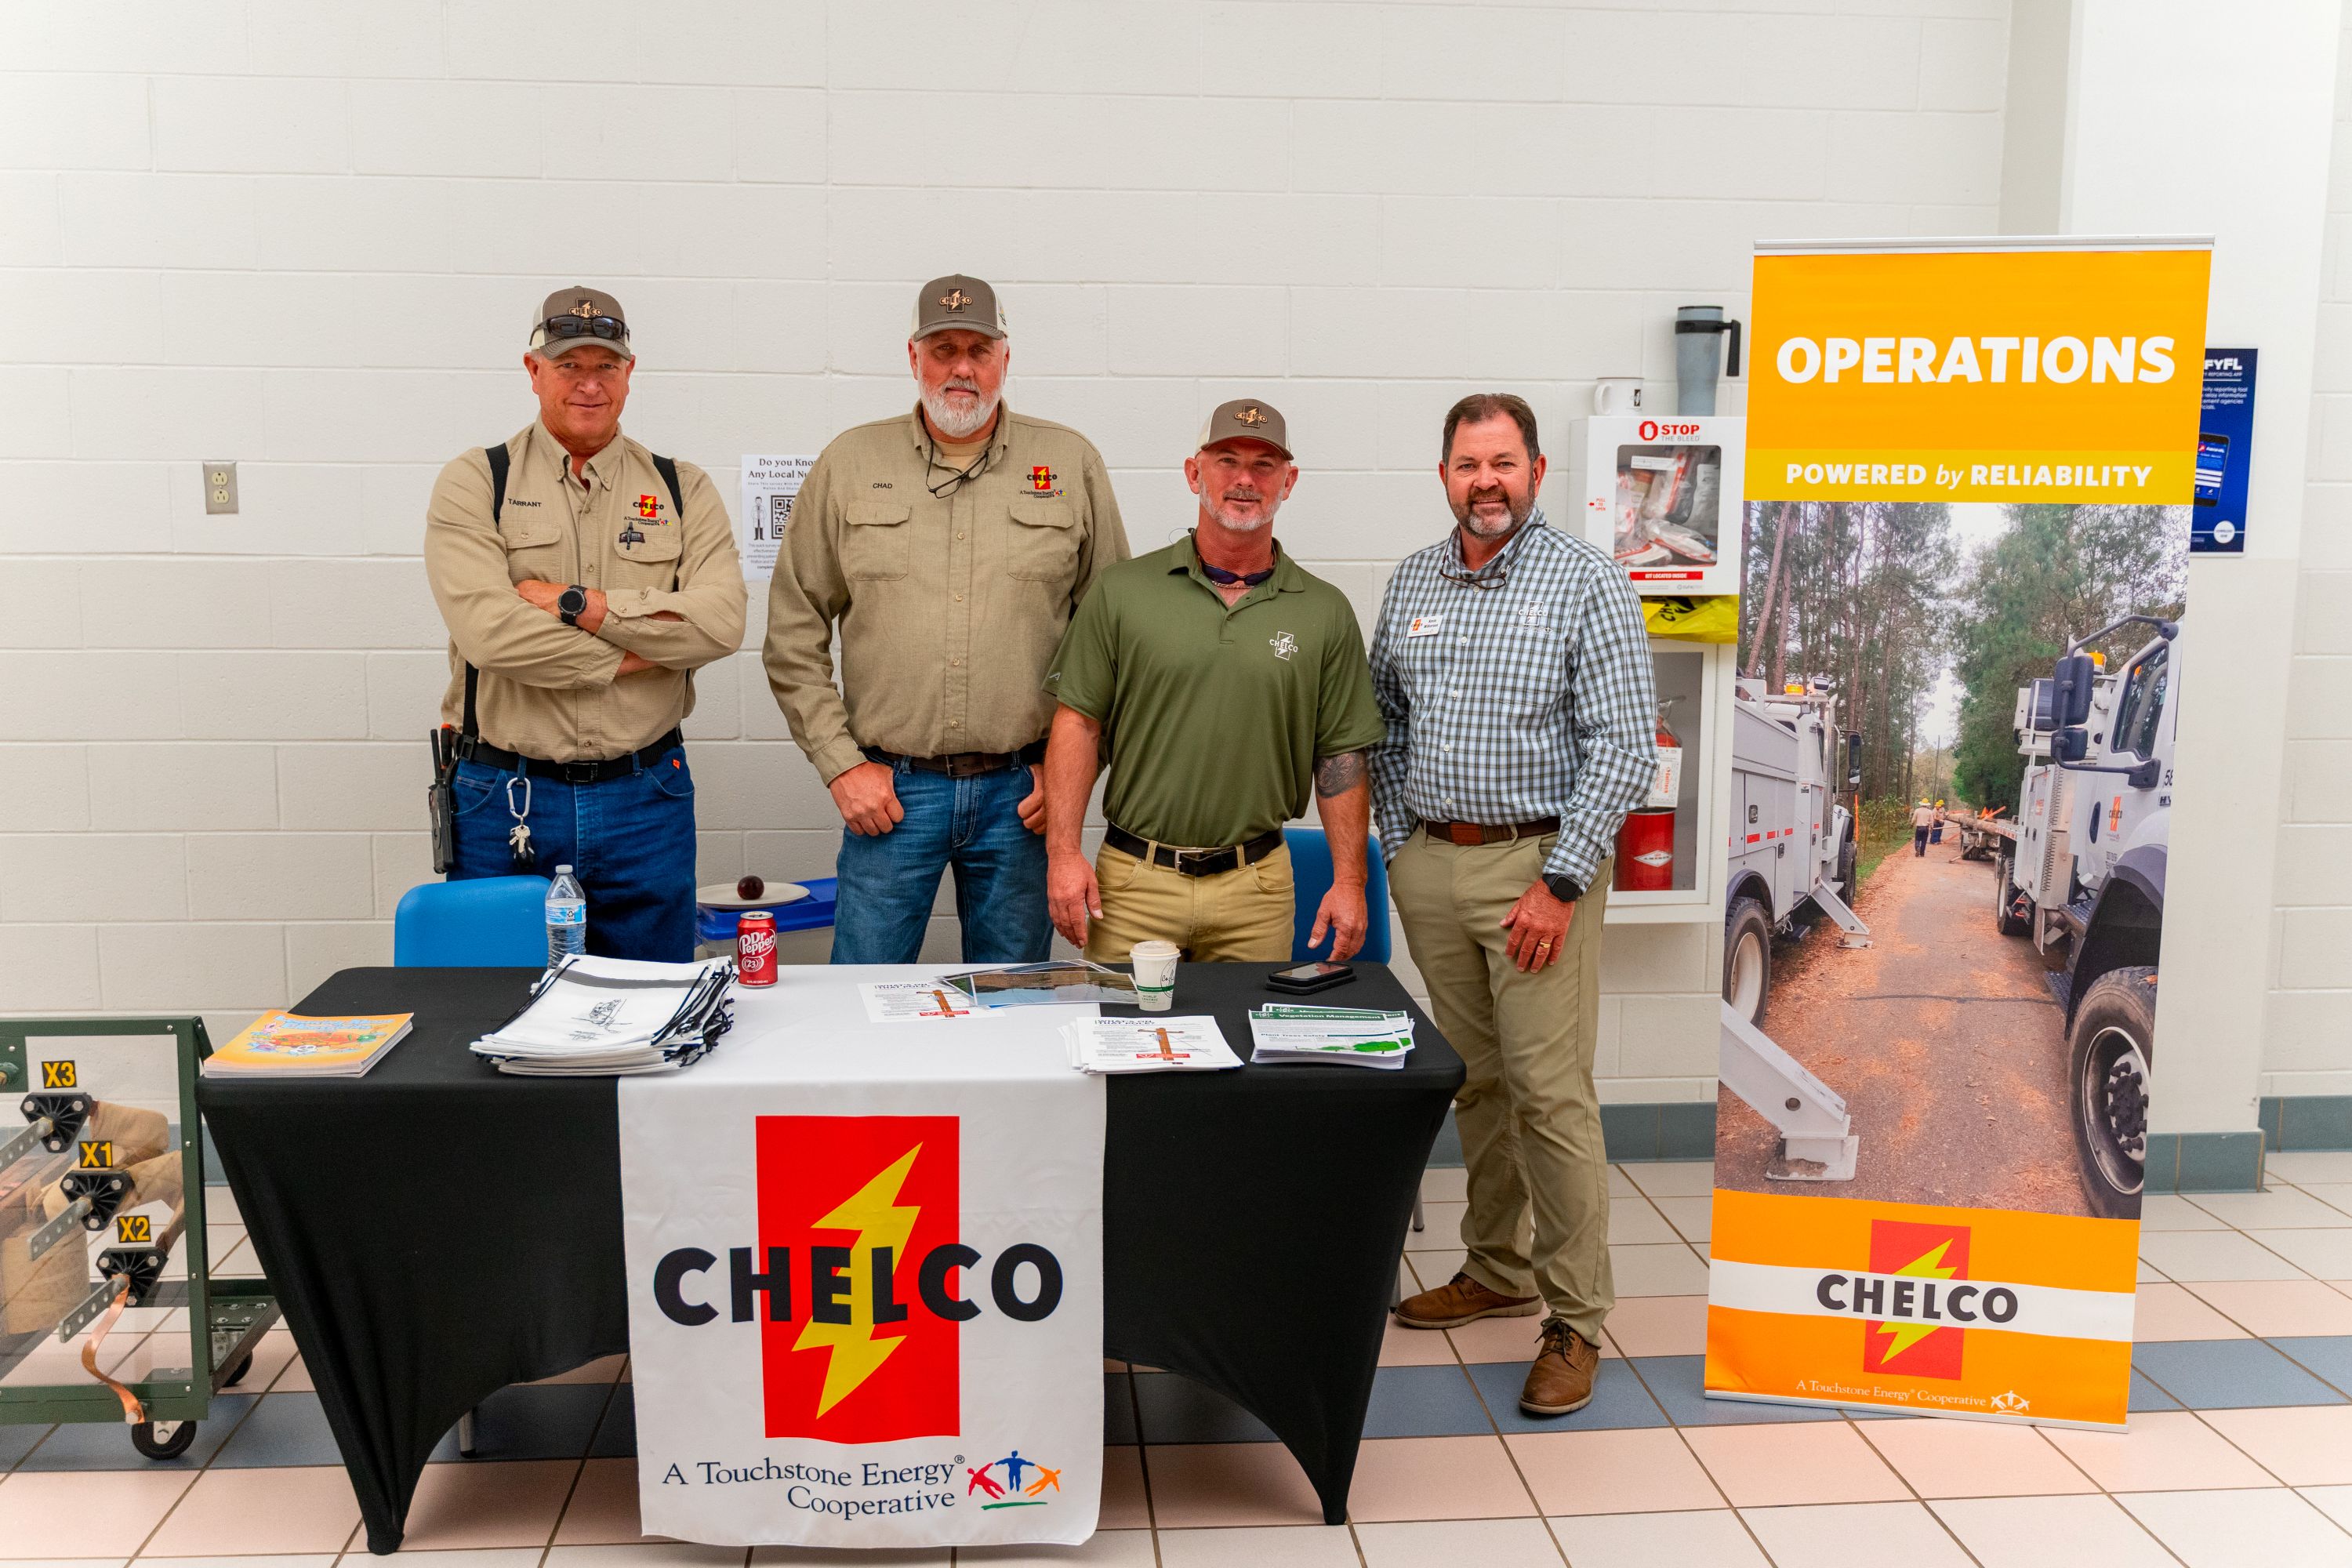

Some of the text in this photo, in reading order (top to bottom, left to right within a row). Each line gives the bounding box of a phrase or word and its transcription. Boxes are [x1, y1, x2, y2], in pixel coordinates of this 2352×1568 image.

[569, 307, 603, 316] CHELCO
[1777, 336, 2175, 383] OPERATIONS
[2204, 358, 2242, 370] FYFL
[1236, 413, 1267, 423] CHELCO
[1661, 424, 1700, 435] STOP
[748, 470, 766, 479] Any
[1787, 463, 2153, 489] POWERED by RELIABILITY
[508, 499, 542, 507] TARRANT
[1269, 639, 1298, 652] CHELCO
[740, 935, 774, 955] Pepper
[750, 931, 767, 944] Dr
[44, 1062, 76, 1087] X3
[82, 1142, 112, 1167] X1
[118, 1217, 151, 1242] X2
[653, 1243, 1063, 1326] CHELCO
[1817, 1274, 2019, 1323] CHELCO
[1796, 1380, 1806, 1391] A
[1809, 1380, 1871, 1396] Touchstone
[1918, 1390, 1987, 1406] Cooperative
[662, 1464, 689, 1485] A
[697, 1457, 852, 1487] Touchstone
[787, 1486, 956, 1521] Cooperative
